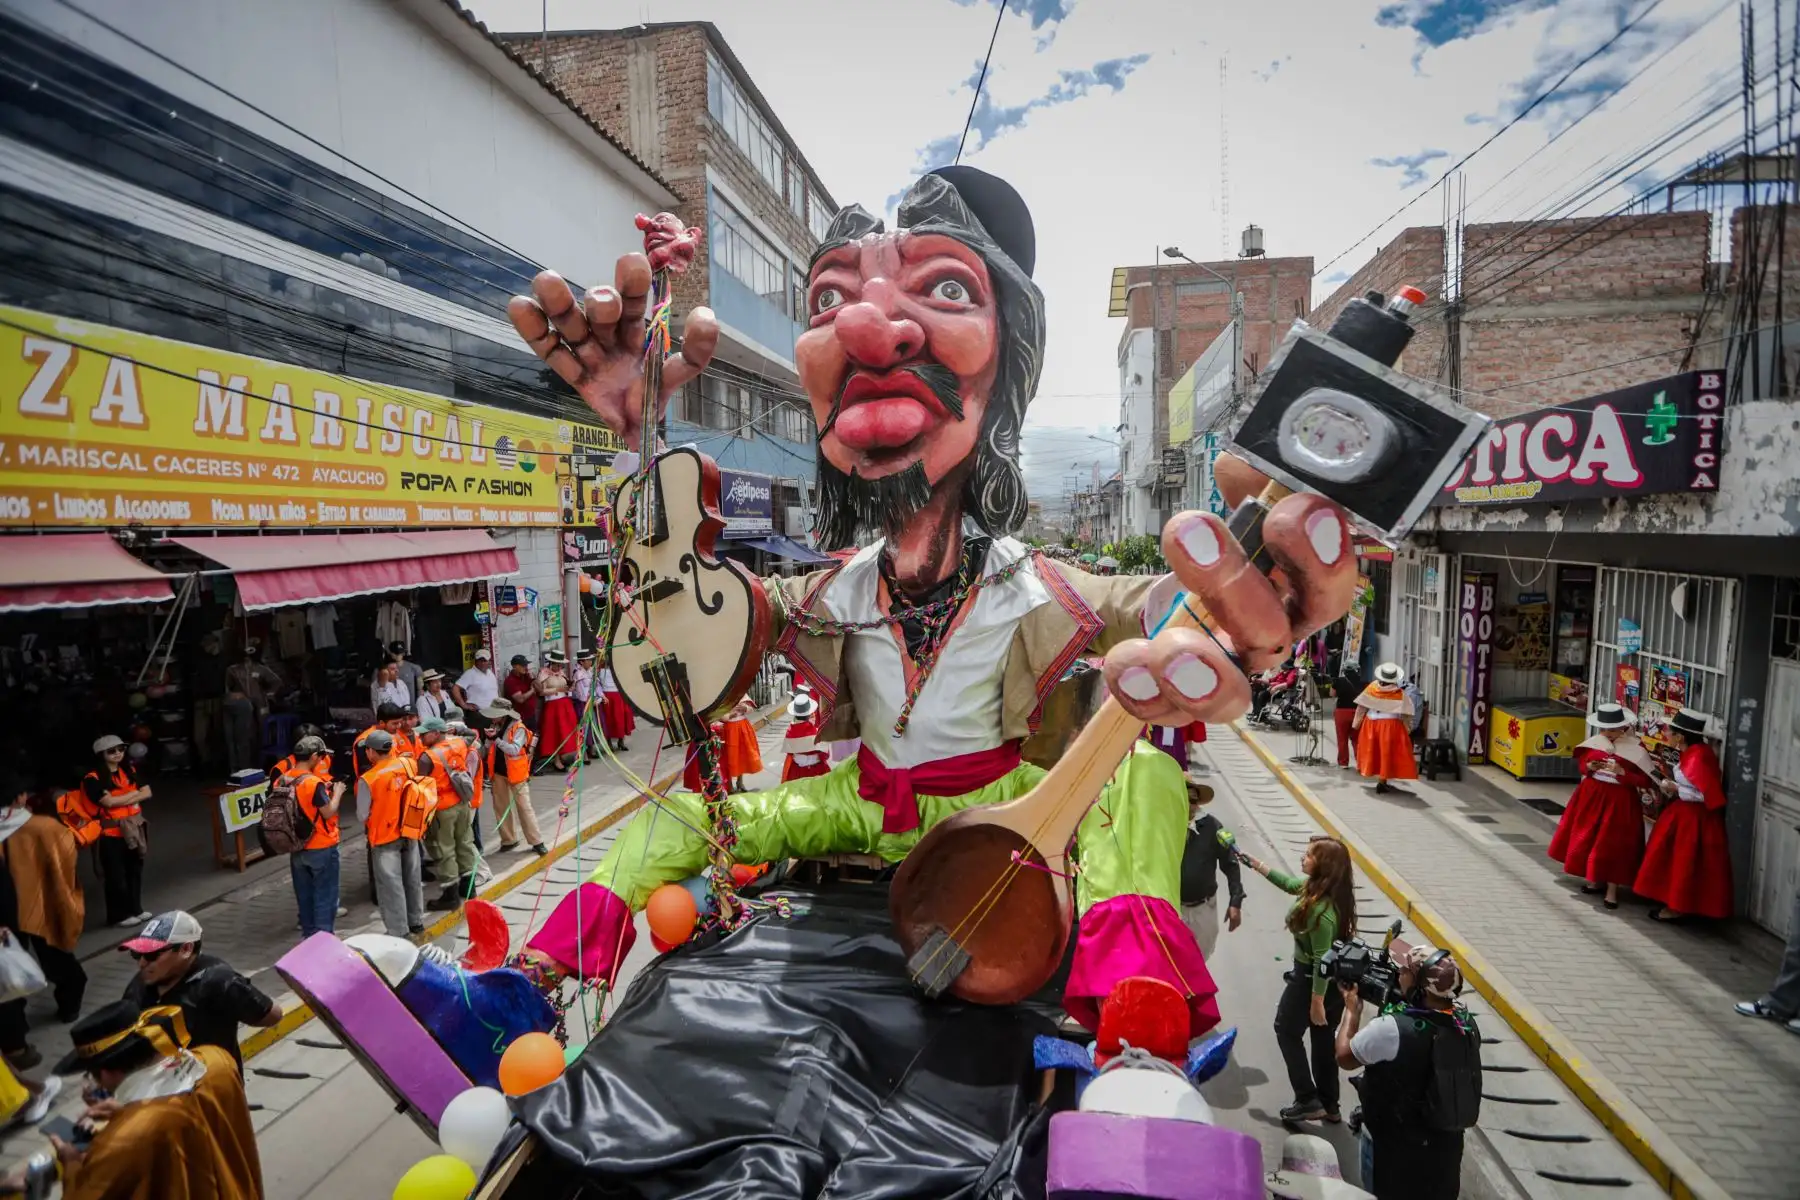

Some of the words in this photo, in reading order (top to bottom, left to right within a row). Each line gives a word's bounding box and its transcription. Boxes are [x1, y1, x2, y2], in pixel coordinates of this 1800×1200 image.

[193, 368, 490, 467] MARISCAL
[1690, 373, 1721, 489] BOTICA
[573, 426, 608, 447] ARANGO
[1444, 403, 1644, 492] TICA
[19, 444, 147, 472] MARISCAL
[153, 454, 243, 478] CACERES
[272, 464, 300, 481] 472
[312, 467, 385, 487] AYACUCHO
[401, 471, 457, 492] ROPA
[464, 477, 533, 496] FASHION
[737, 481, 770, 502] edipesa
[115, 493, 191, 520] ALGODONES
[211, 498, 244, 520] MODA
[1469, 585, 1493, 754] BOTICA
[237, 790, 269, 818] BA
